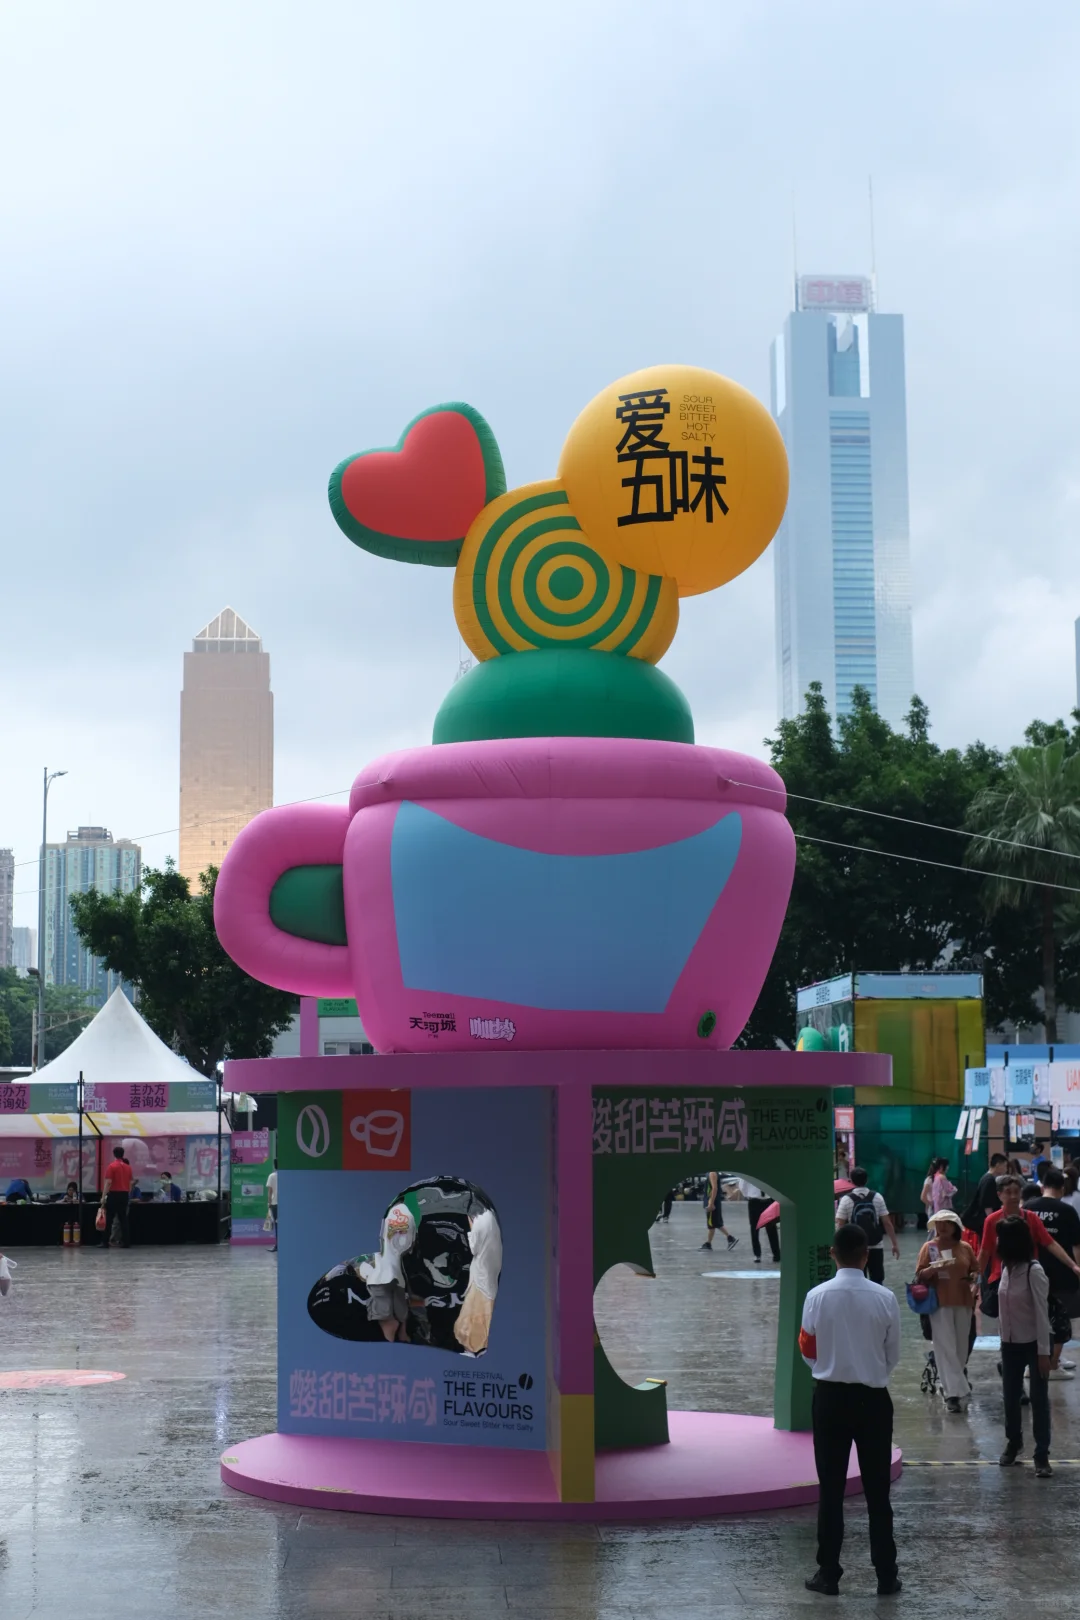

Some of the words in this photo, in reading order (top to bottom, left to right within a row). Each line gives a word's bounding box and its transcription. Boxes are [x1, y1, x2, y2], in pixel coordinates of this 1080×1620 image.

[683, 395, 713, 404] SOUR
[679, 403, 716, 413] SWEET
[616, 388, 671, 454] 爱
[679, 412, 717, 423] BITTER
[686, 422, 710, 432] HOT
[681, 431, 716, 442] SALTY
[617, 446, 729, 527] 五味
[422, 1011, 455, 1020] Teemall
[409, 1017, 457, 1034] 天河城
[130, 1084, 166, 1096] 主办方
[130, 1096, 166, 1109] 咨询处
[750, 1108, 780, 1123] THE
[784, 1108, 815, 1123] FIVE
[749, 1126, 829, 1142] FLAVOURS
[443, 1369, 471, 1379] COFFEE
[472, 1370, 504, 1381] FESTIVAL
[290, 1368, 437, 1426] 酸甜苦辣咸
[443, 1381, 476, 1397] THE
[482, 1383, 518, 1400] FIVE
[444, 1400, 533, 1421] FLAVOURS
[443, 1419, 458, 1427] Sour
[460, 1419, 481, 1428] Sweet
[482, 1421, 501, 1429] Bitter
[503, 1423, 515, 1431] Hot
[517, 1423, 534, 1433] Salty
